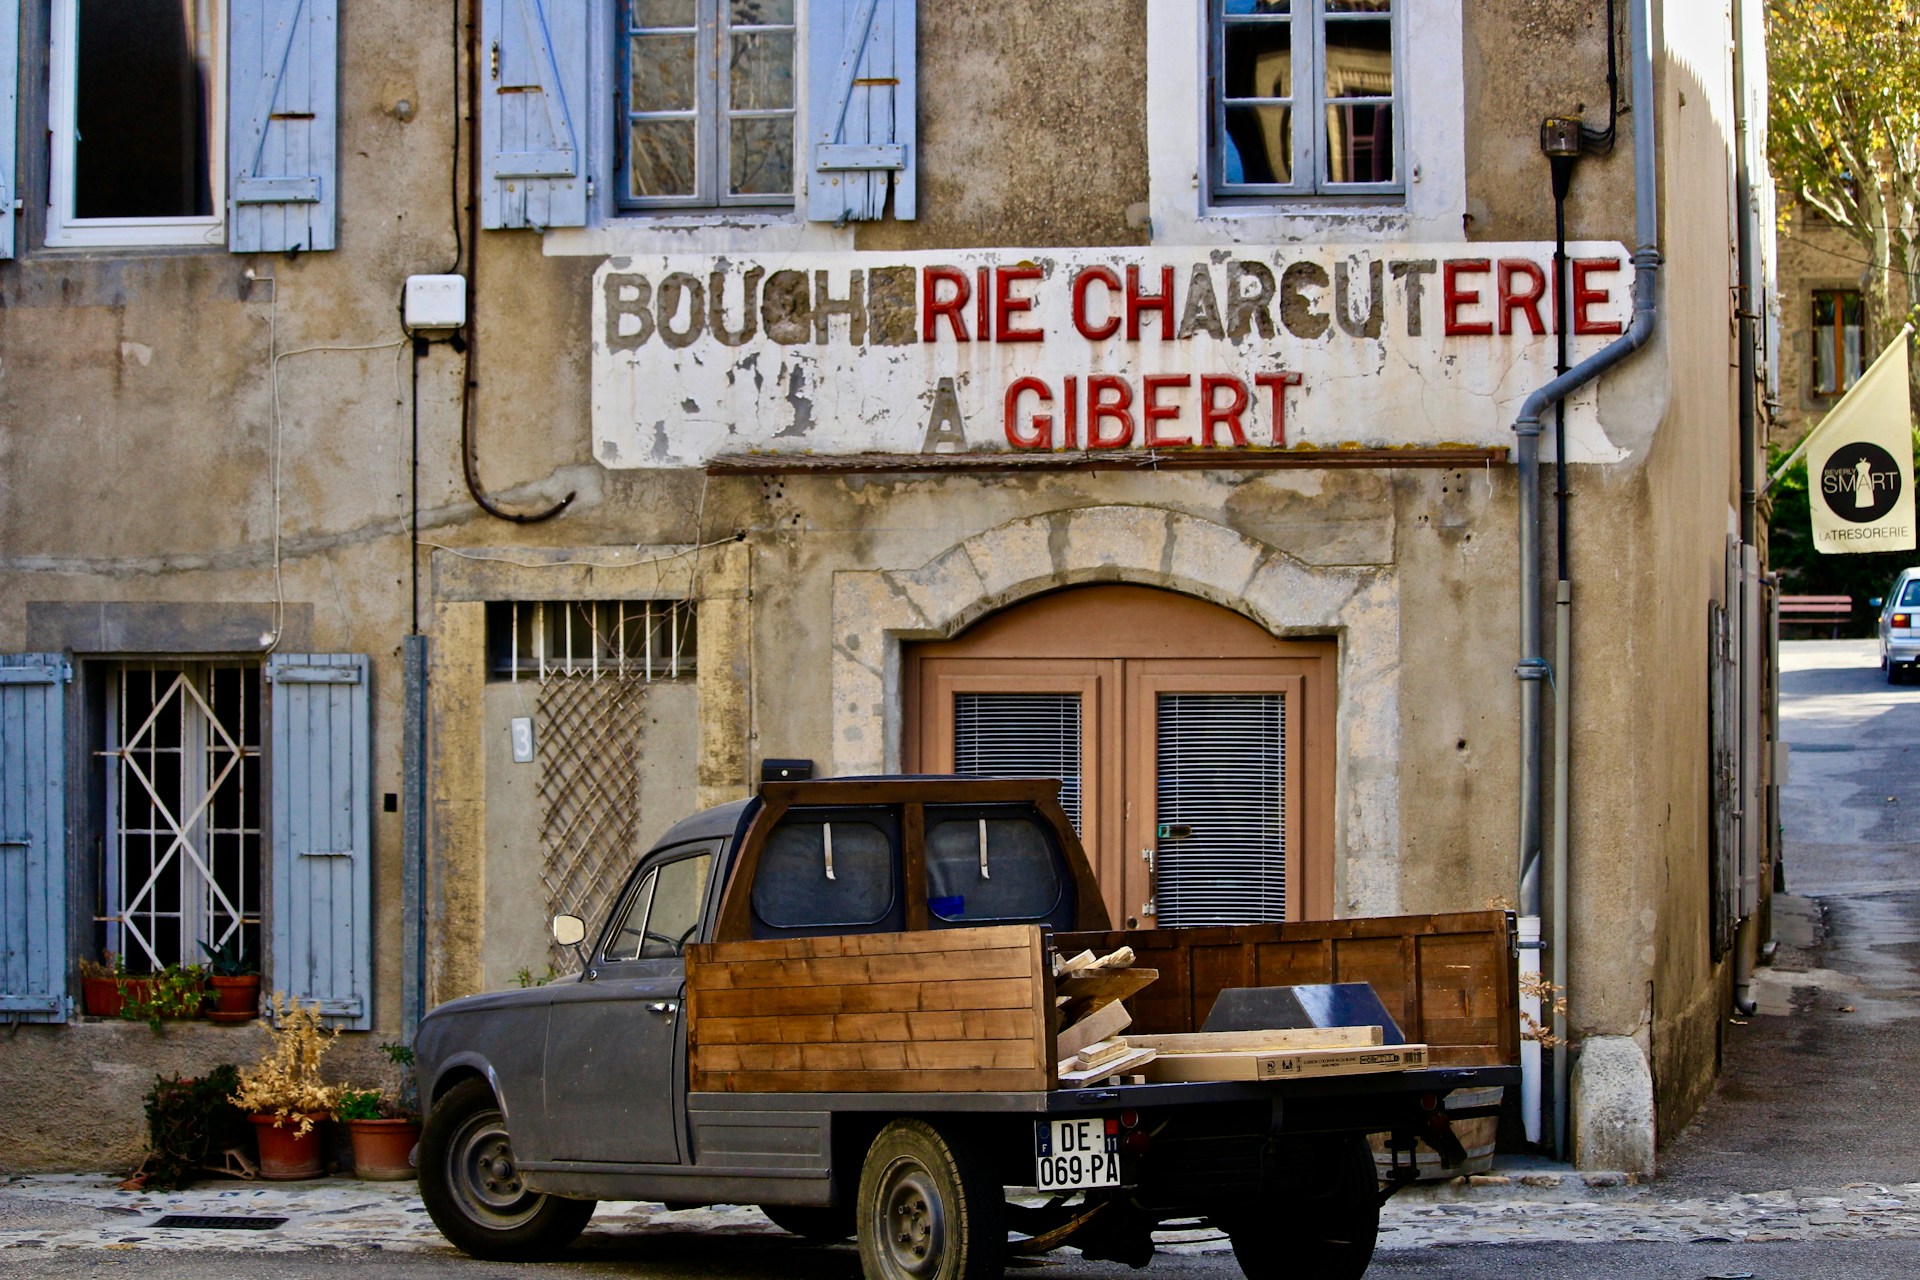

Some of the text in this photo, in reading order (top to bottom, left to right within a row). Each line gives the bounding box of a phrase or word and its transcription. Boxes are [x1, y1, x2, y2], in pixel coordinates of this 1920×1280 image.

[605, 258, 1622, 354] BOUCHRIE CHARCUTERIE
[921, 372, 1302, 454] A GIBERT
[1823, 471, 1898, 493] SMART
[515, 724, 530, 757] 3
[1042, 1144, 1047, 1152] F
[1106, 1137, 1118, 1151] 11
[1041, 1154, 1118, 1186] 069-PA
